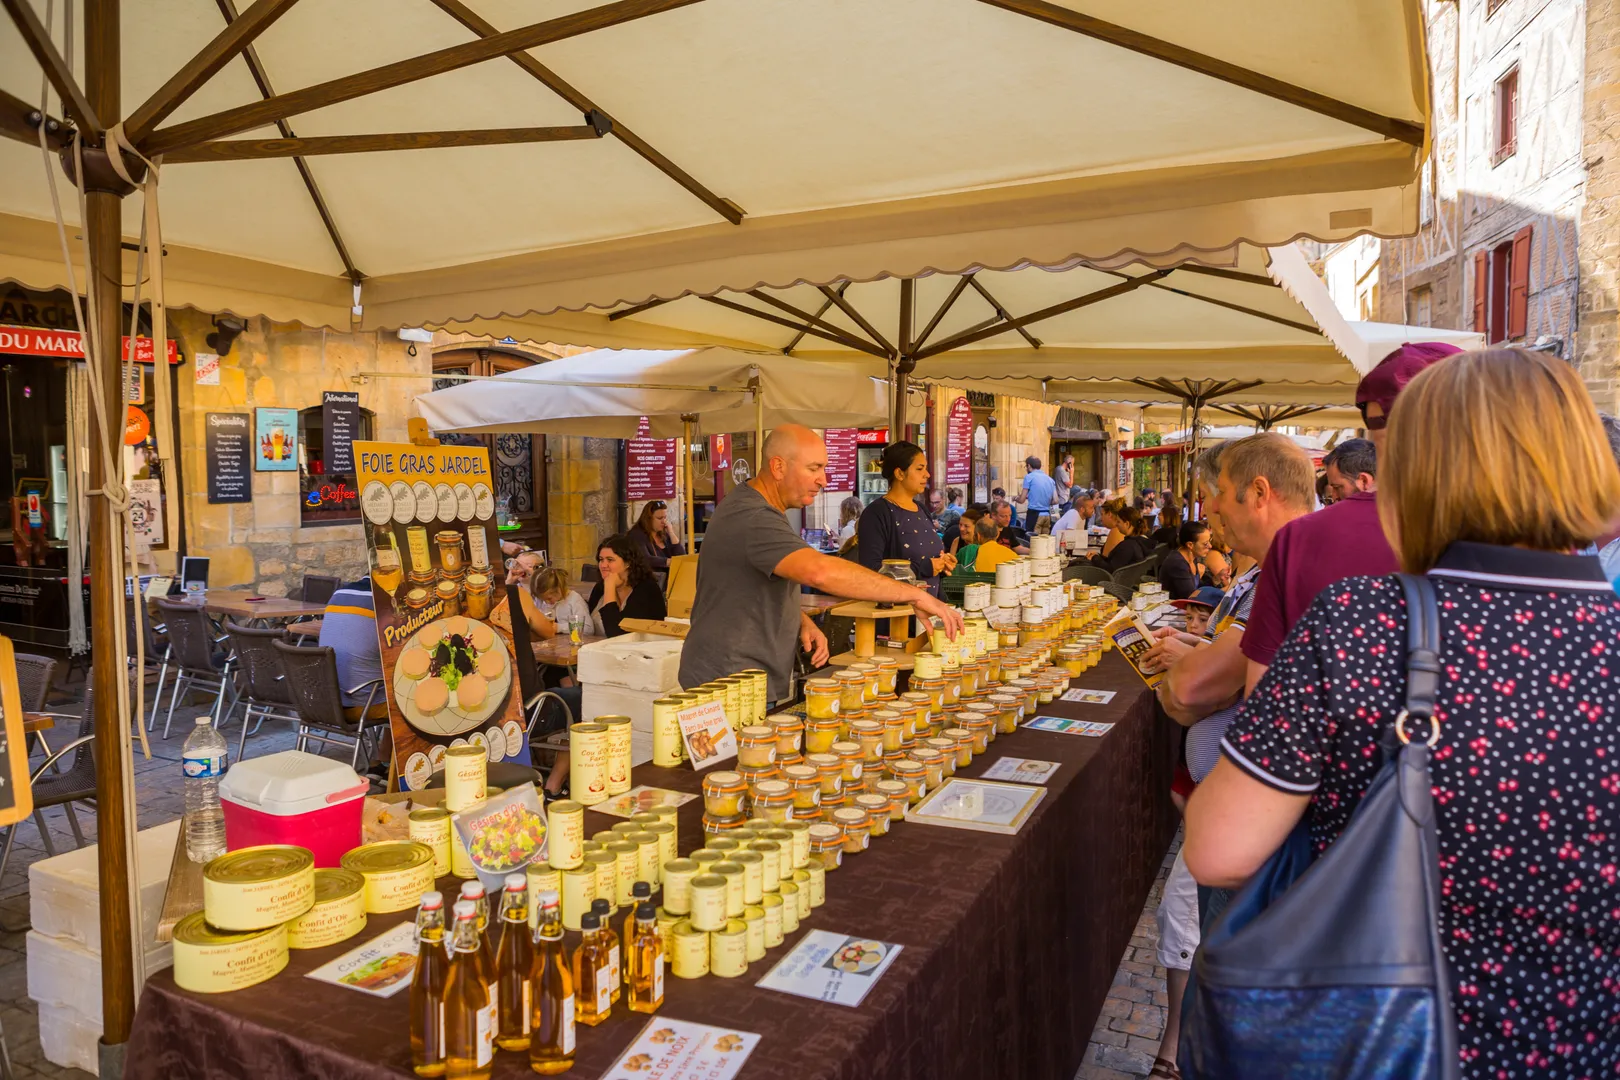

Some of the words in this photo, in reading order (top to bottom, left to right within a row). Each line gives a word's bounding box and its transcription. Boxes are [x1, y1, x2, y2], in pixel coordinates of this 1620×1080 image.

[0, 333, 29, 349] DU
[361, 453, 394, 474] FOIE
[400, 453, 435, 475] GRAS
[440, 455, 487, 475] JARDEL
[320, 484, 356, 503] Coffee
[132, 511, 144, 521] 24
[384, 599, 445, 648] Producteur
[680, 710, 697, 721] Magret
[697, 709, 704, 717] de
[703, 704, 721, 715] Canard
[457, 768, 482, 778] Gésiers
[393, 882, 416, 892] Confit
[270, 890, 296, 903] Confit
[298, 918, 325, 928] Confit
[327, 913, 348, 924] d'Oie
[227, 956, 256, 968] Confit
[258, 947, 277, 960] d'Oie
[338, 948, 380, 972] Confit
[656, 1057, 674, 1070] DE
[666, 1035, 692, 1057] NOIX
